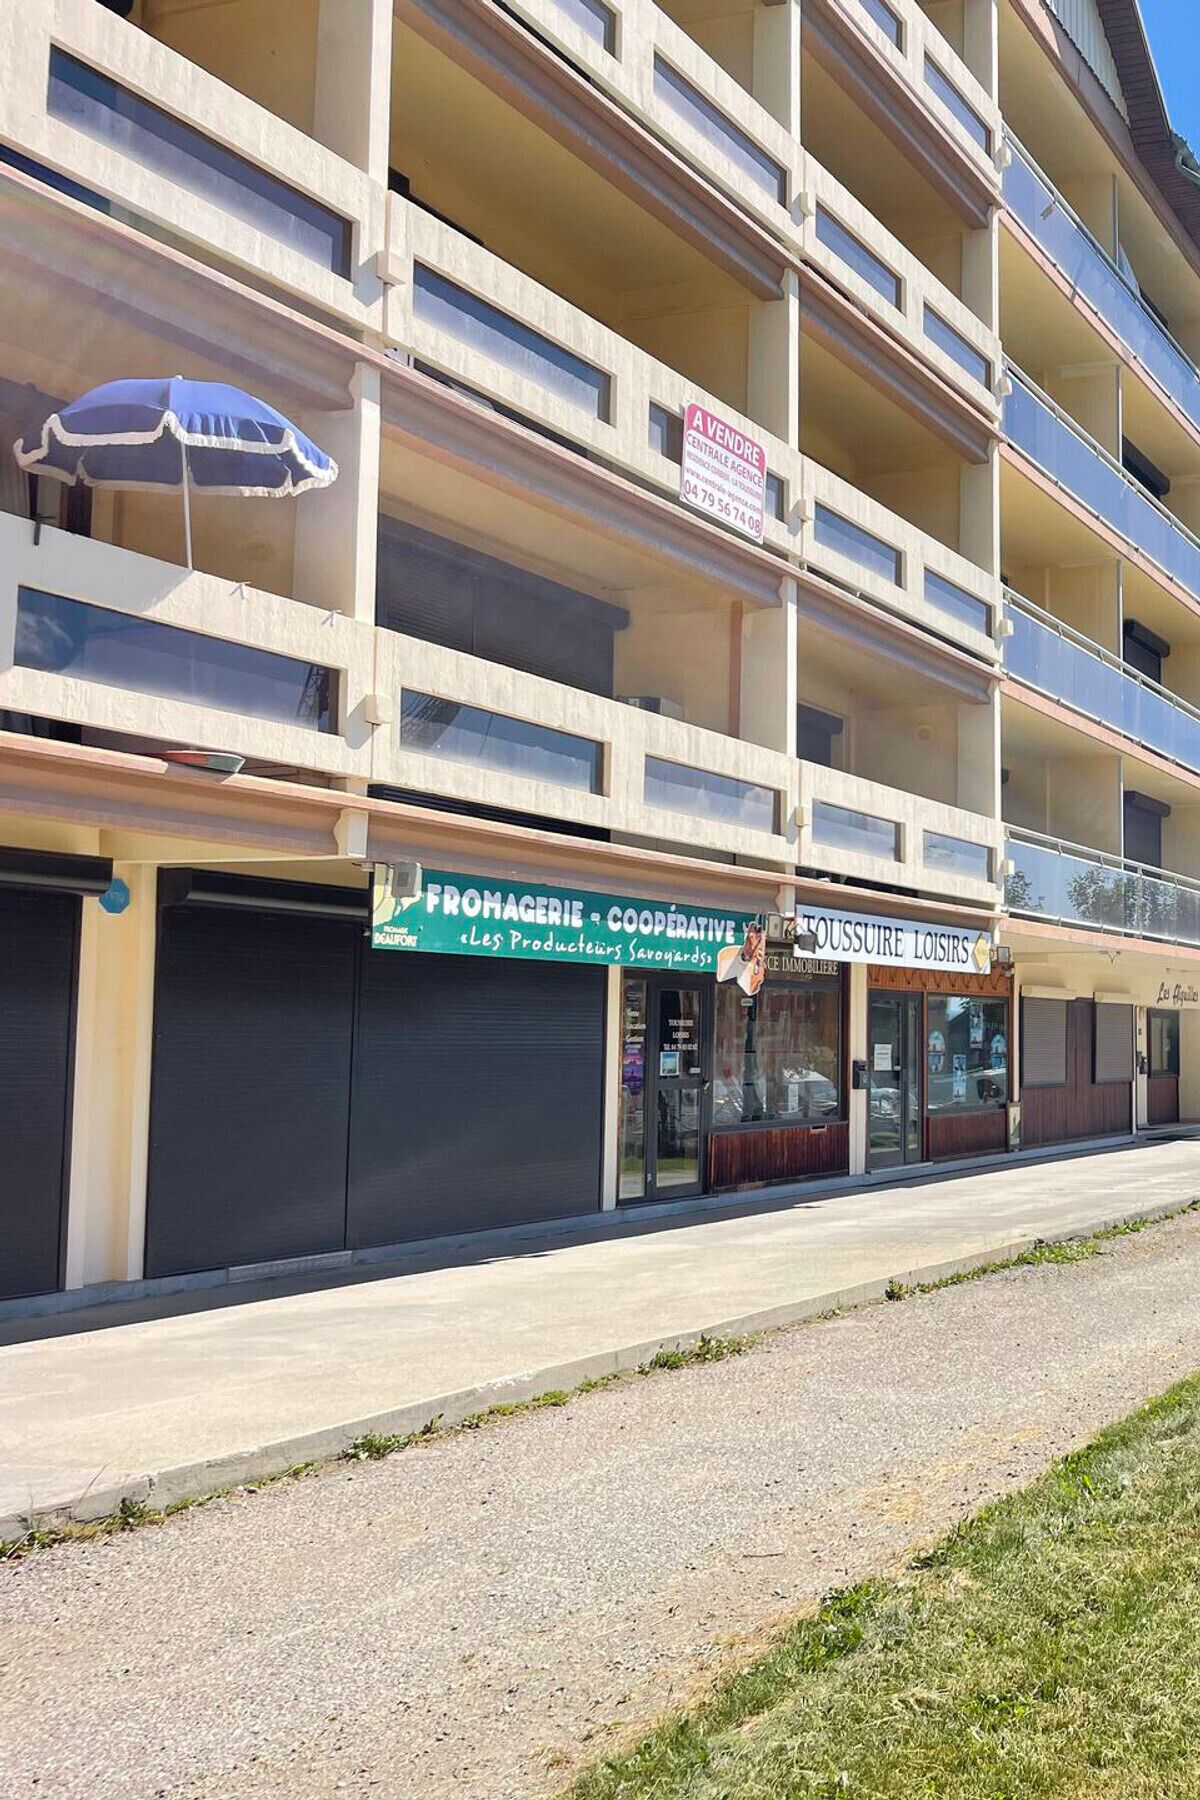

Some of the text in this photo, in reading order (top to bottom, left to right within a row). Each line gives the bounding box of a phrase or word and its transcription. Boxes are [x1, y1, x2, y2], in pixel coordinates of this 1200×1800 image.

[687, 433, 729, 468] CENTRALE
[730, 460, 763, 489] AGENCE
[693, 410, 760, 467] A VENDRE
[684, 480, 761, 534] 04 79 56 74 08
[427, 883, 584, 928] FROMAGERIE
[606, 904, 736, 944] COOPÉRATIVE
[509, 929, 622, 960] Producteurs
[914, 929, 970, 964] LOISIRS
[1156, 981, 1169, 1004] Les
